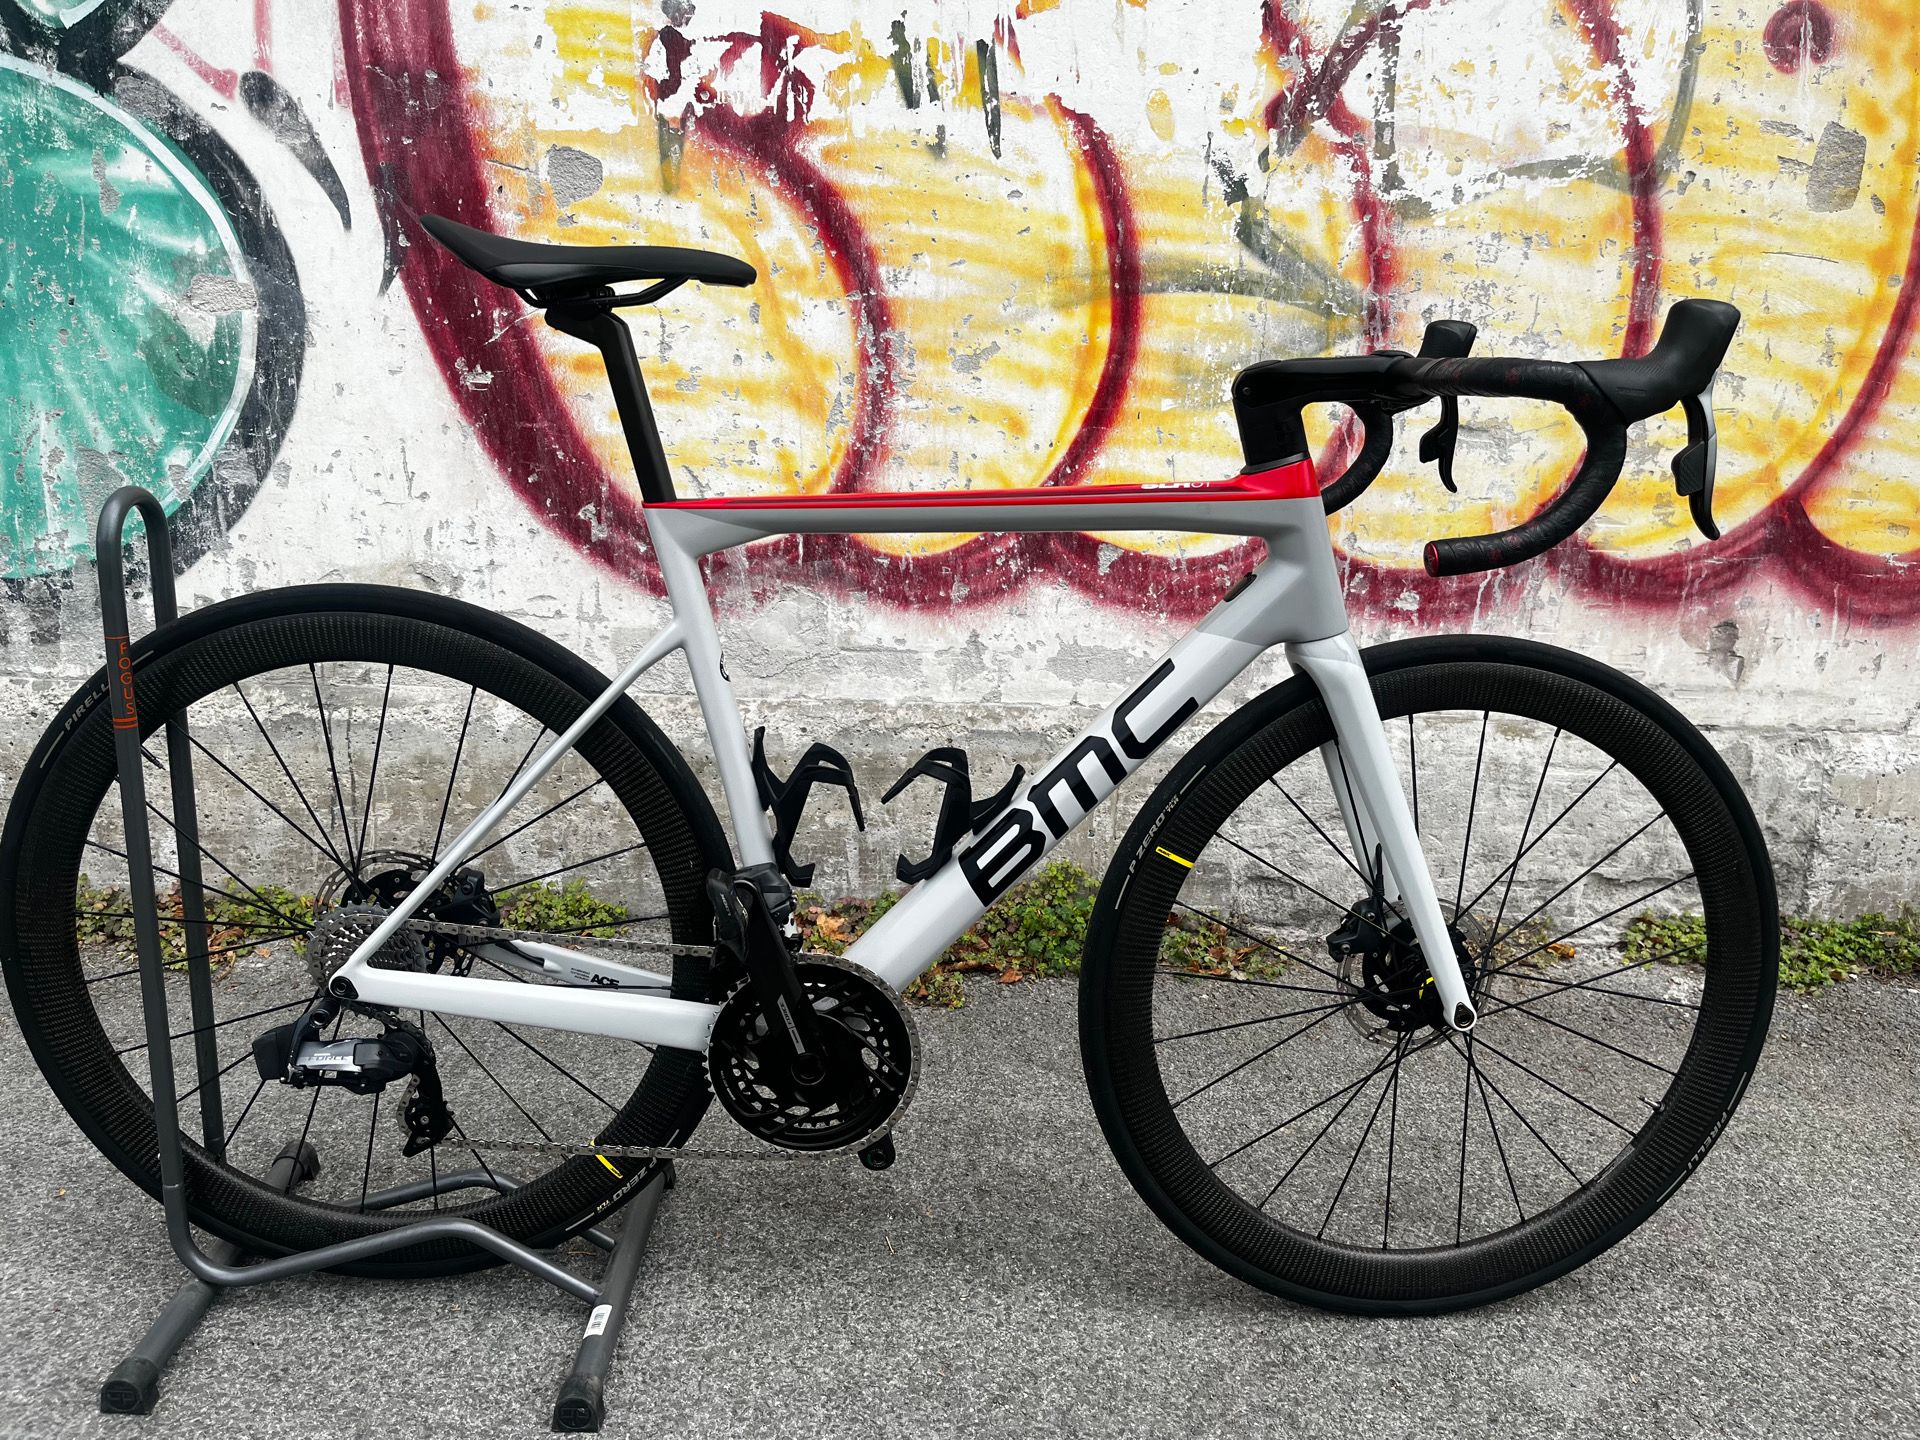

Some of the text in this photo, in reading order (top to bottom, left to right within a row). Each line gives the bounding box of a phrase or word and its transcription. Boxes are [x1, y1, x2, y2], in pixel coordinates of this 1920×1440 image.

[65, 683, 110, 731] PIRELL
[958, 658, 1199, 907] BMC
[1129, 859, 1137, 874] P
[1136, 812, 1165, 859] ZERO
[590, 974, 620, 990] ACE
[1687, 1111, 1727, 1170] PIRELLI
[613, 1156, 657, 1201] P ZERO
